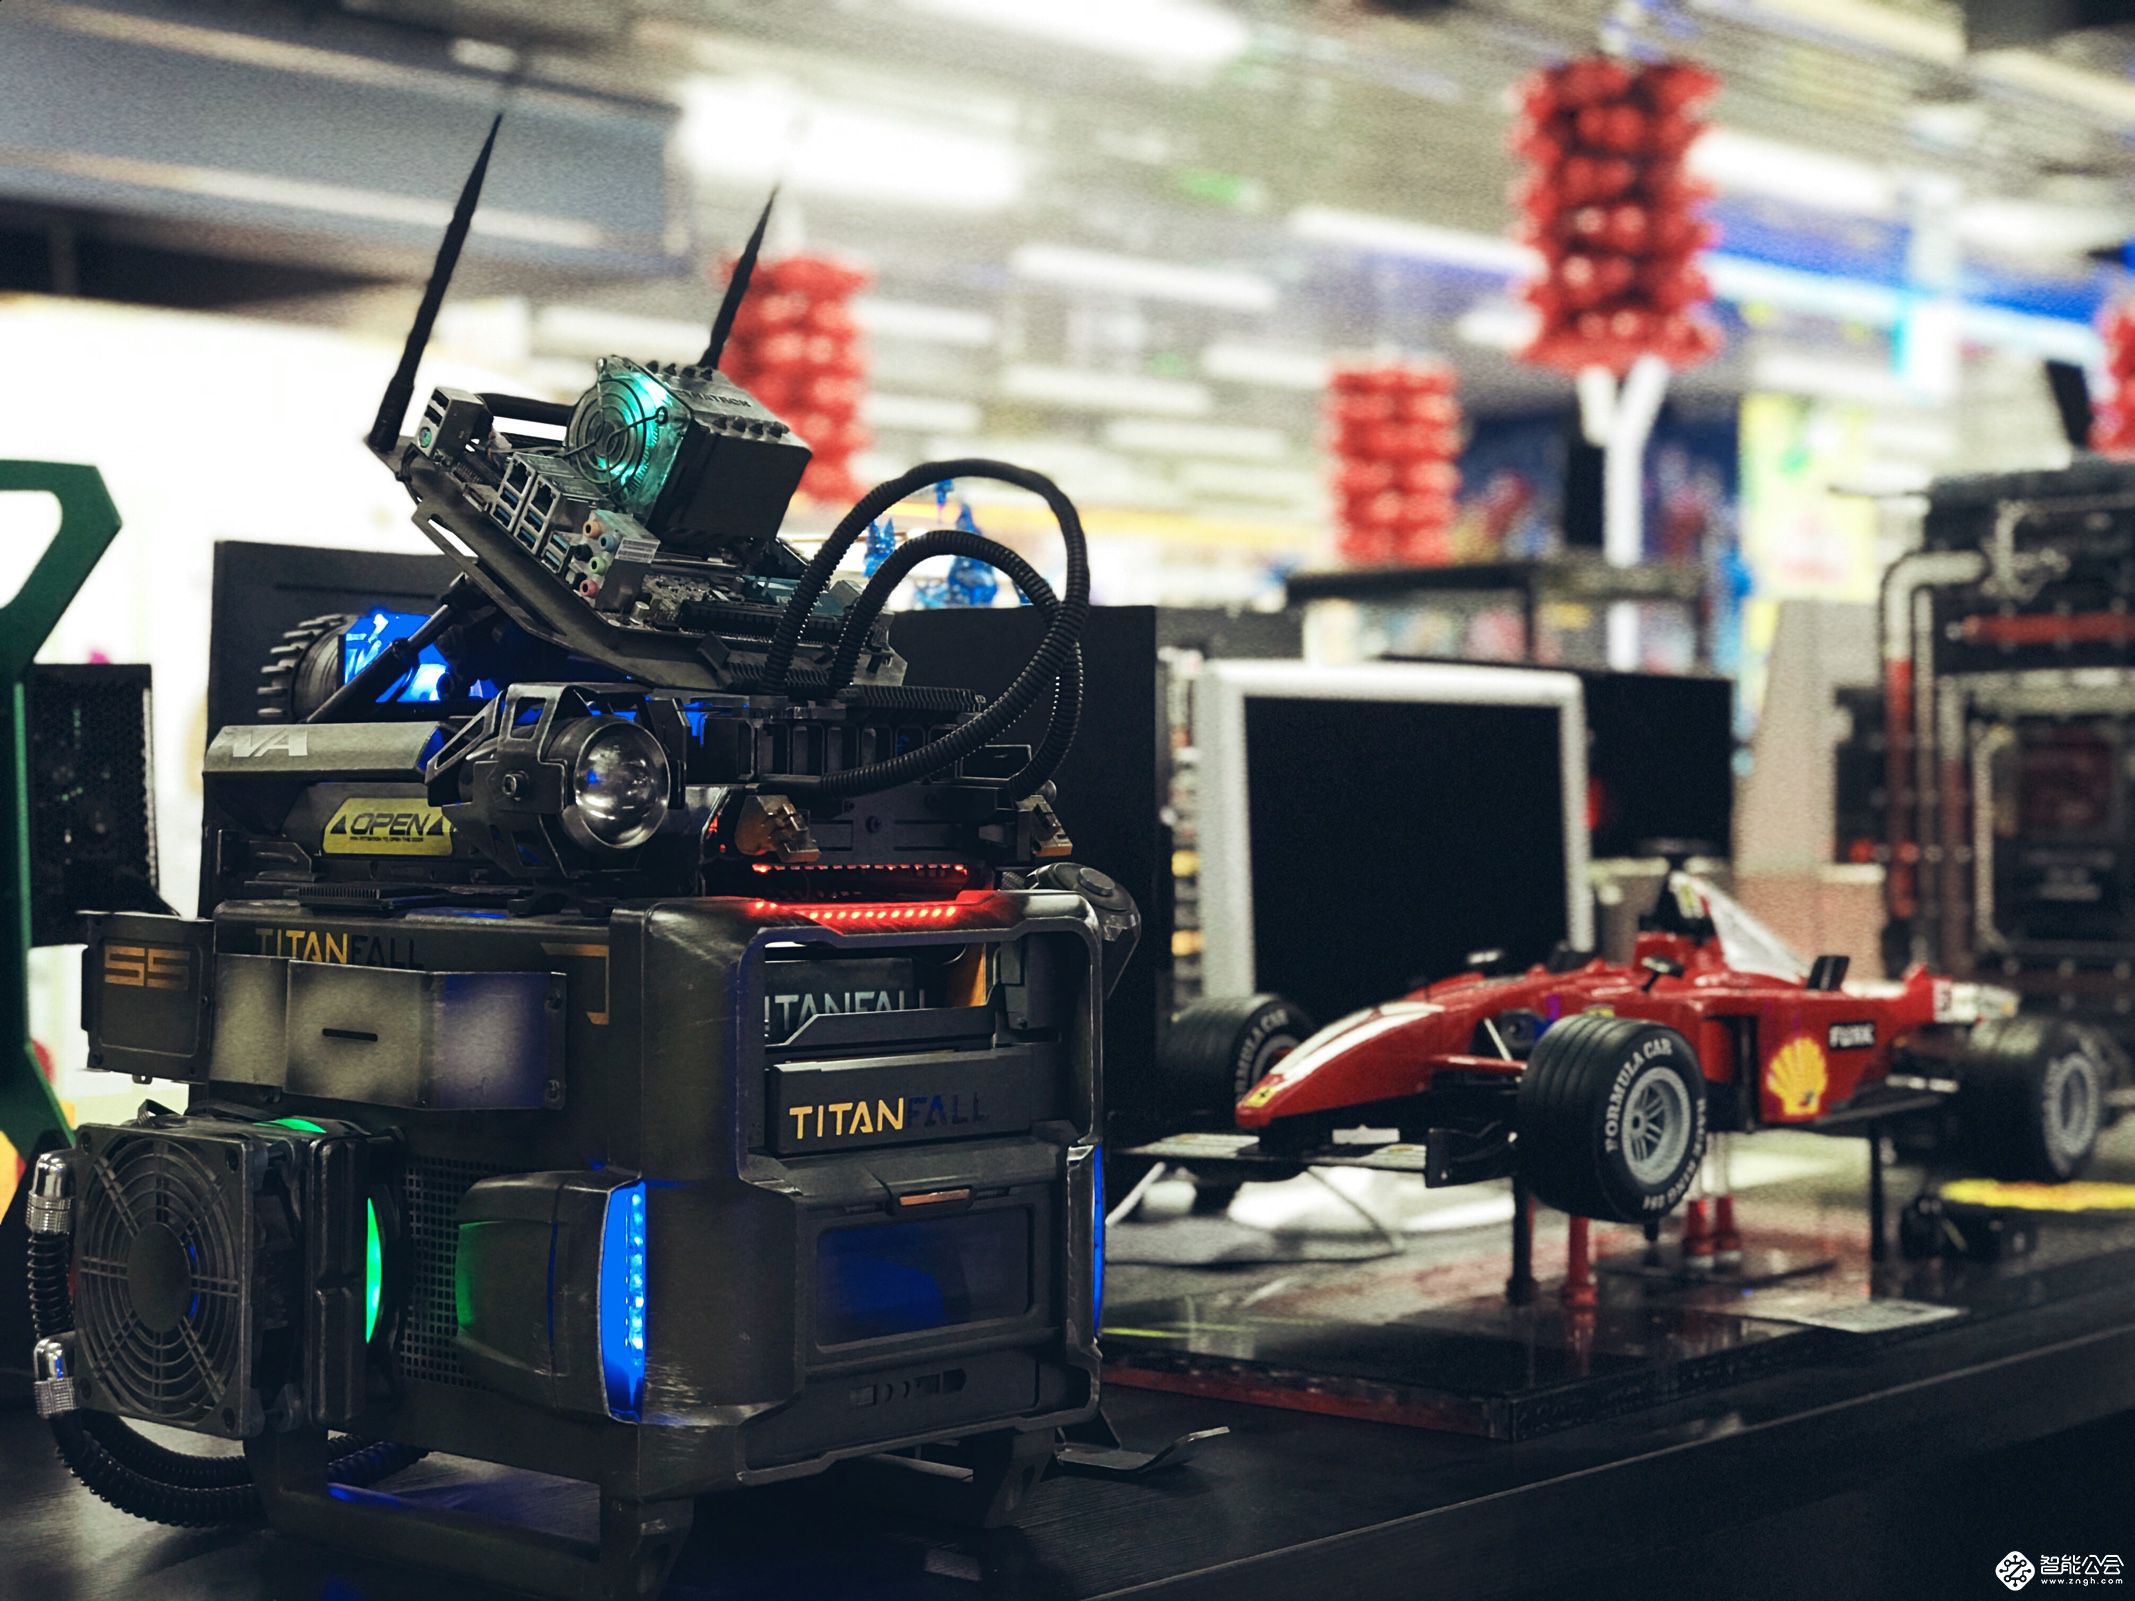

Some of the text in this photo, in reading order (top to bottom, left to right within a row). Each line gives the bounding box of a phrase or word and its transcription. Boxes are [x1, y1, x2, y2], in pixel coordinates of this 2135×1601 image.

[350, 813, 430, 835] OPEN
[256, 928, 424, 968] TITANFALL
[789, 1094, 990, 1140] TITANFALL
[1604, 1038, 1673, 1153] FORMULA CAR
